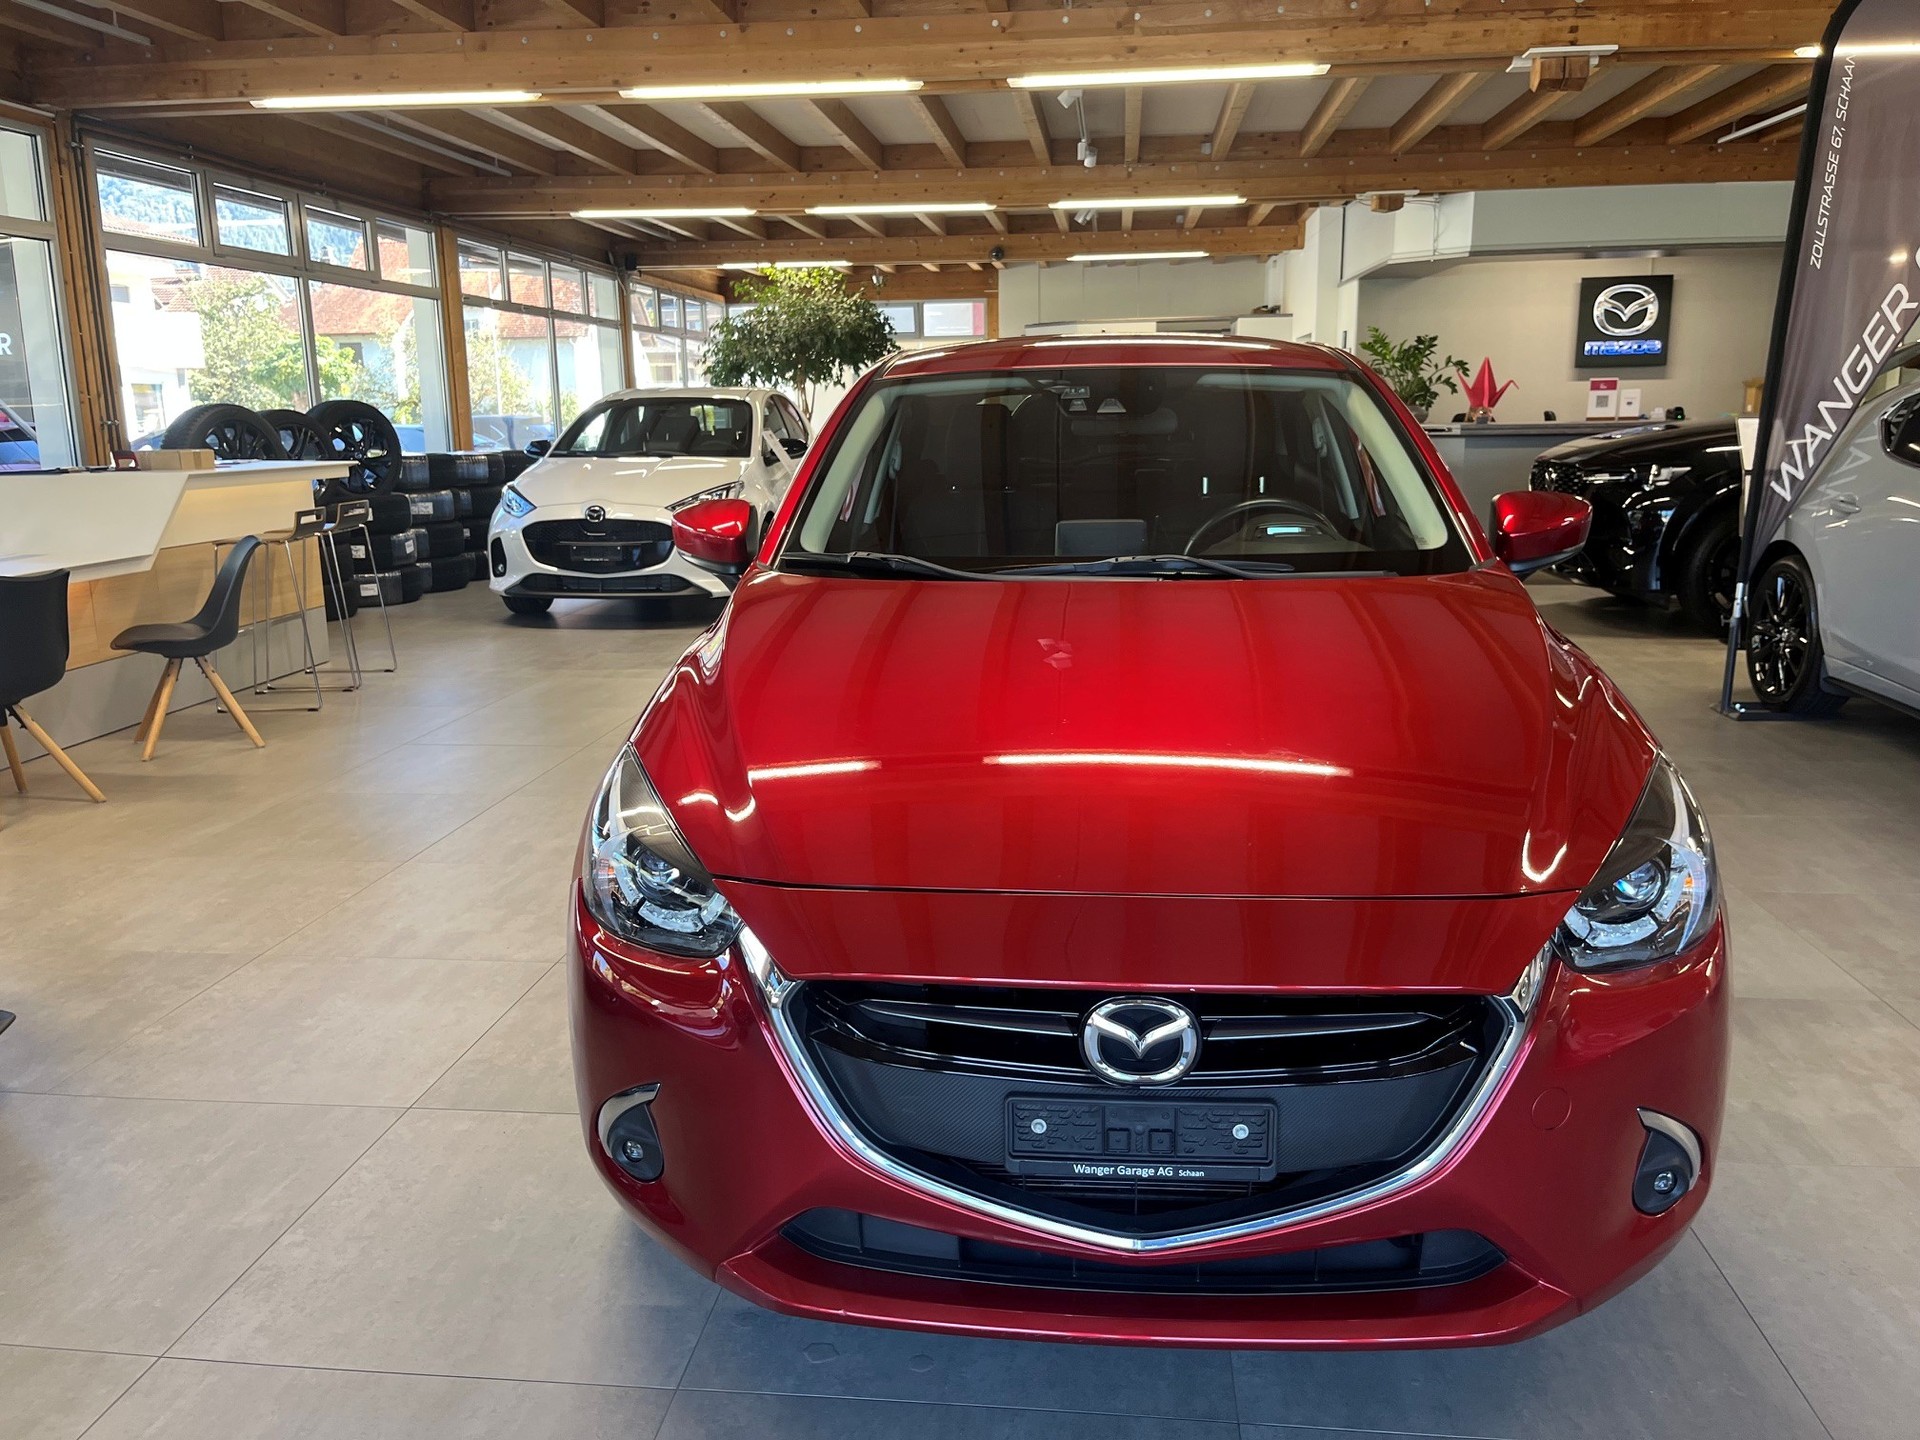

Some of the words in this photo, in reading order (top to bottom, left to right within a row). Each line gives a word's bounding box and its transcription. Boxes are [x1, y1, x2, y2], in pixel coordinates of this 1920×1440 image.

[1810, 150, 1840, 270] ZOLLSTRASSE
[1831, 125, 1847, 149] 67,
[1583, 339, 1663, 356] mazda
[1769, 283, 1919, 503] WANGER
[1072, 1163, 1115, 1177] Wanger
[1116, 1165, 1155, 1178] Garage
[1156, 1166, 1174, 1177] AG
[1178, 1169, 1205, 1177] Schaan
